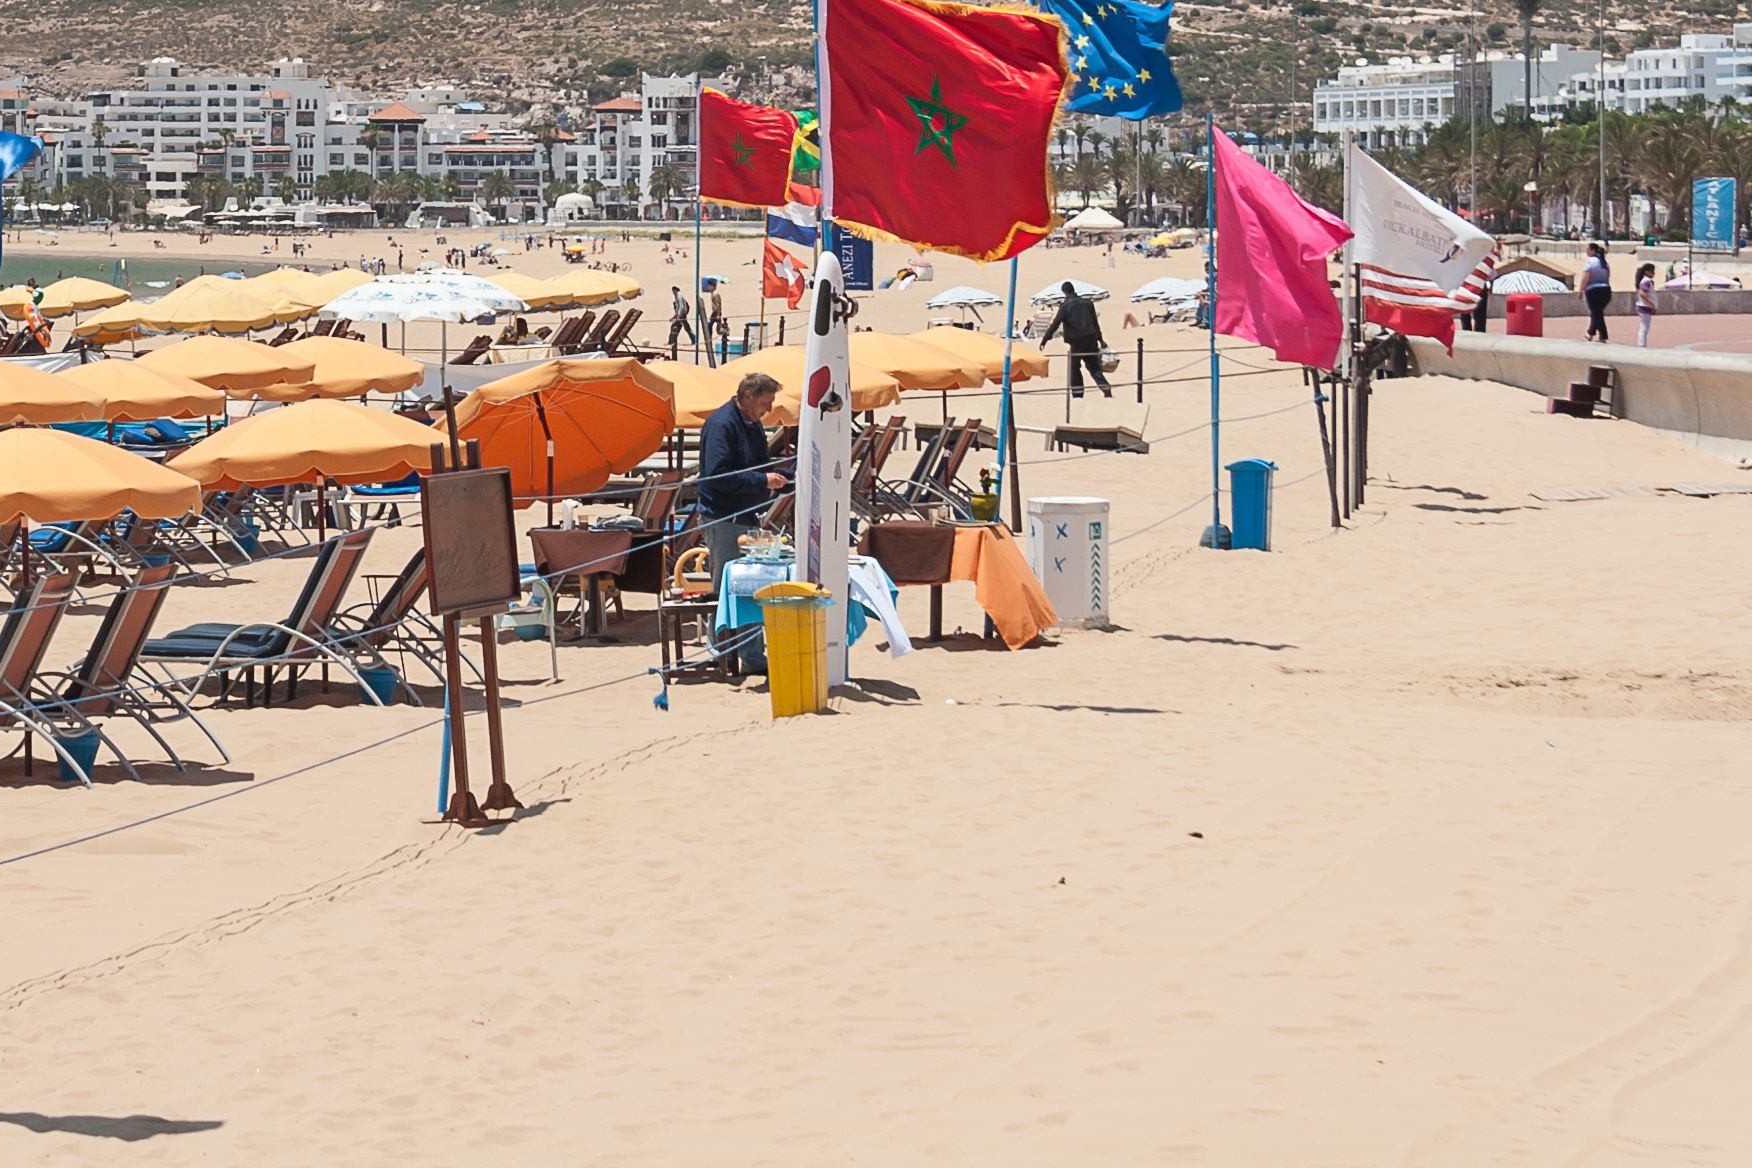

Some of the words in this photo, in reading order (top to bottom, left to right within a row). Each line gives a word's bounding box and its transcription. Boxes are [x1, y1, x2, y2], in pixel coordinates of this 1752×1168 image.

[1705, 180, 1720, 239] ATLANTIC
[839, 226, 853, 241] TO
[1691, 240, 1731, 248] HOTEL
[842, 244, 854, 280] ANEZI
